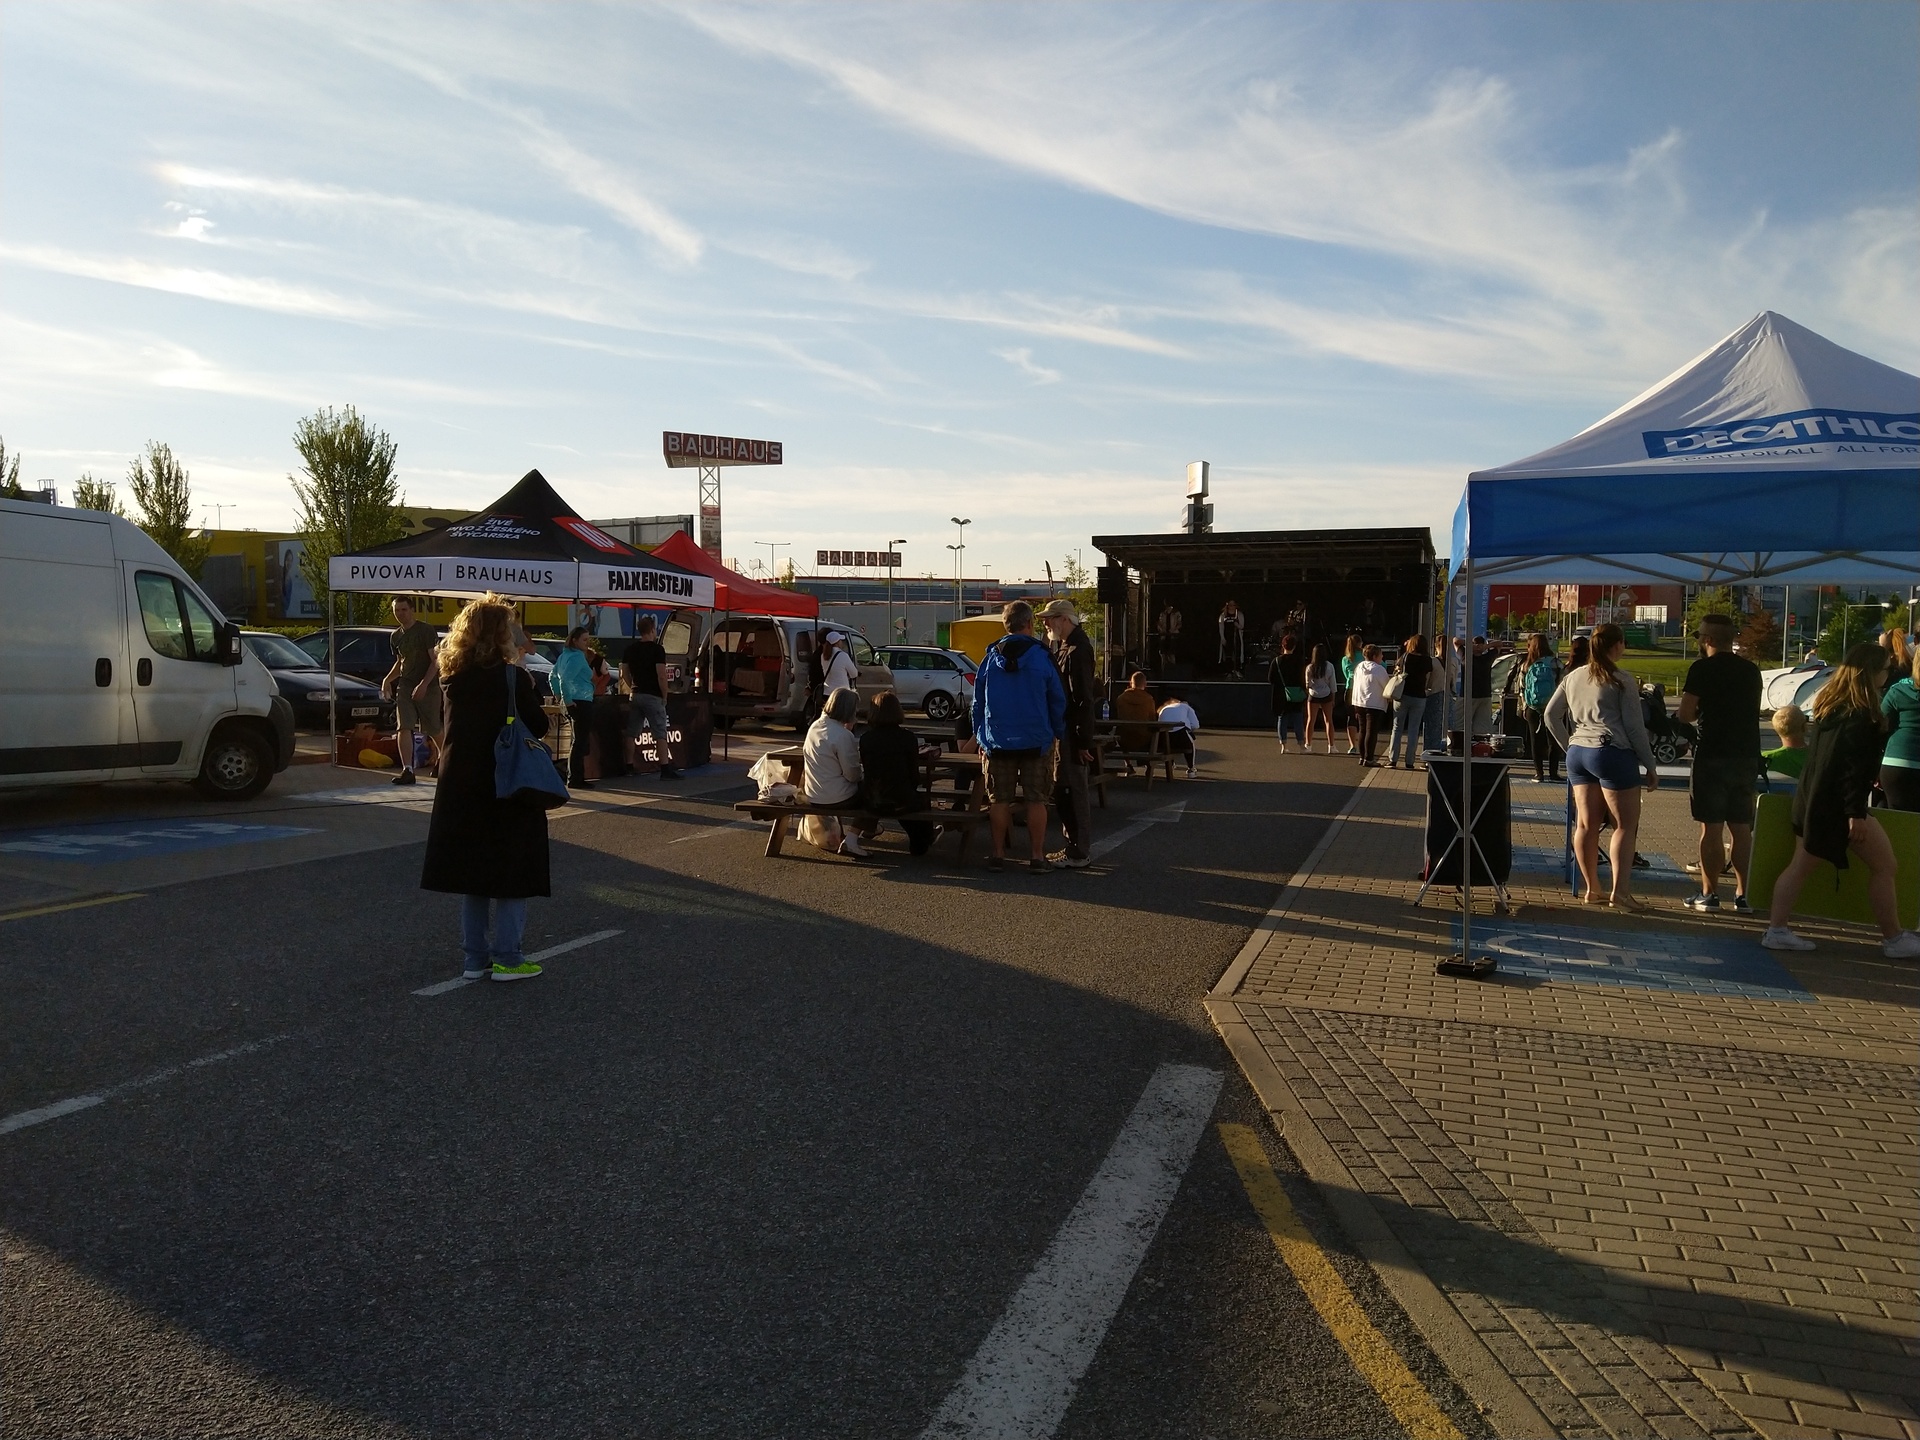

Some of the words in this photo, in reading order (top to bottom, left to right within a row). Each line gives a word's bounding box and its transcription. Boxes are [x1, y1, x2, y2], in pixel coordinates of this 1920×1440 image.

[668, 434, 781, 461] BAUHAUS
[1783, 446, 1823, 455] ALL
[1836, 445, 1875, 453] ALL
[485, 524, 541, 536] ČESKÉHO
[818, 551, 901, 566] BAUHAUS
[351, 564, 426, 579] PIVOVAR
[455, 564, 553, 585] BRAUHAUS
[607, 570, 693, 597] FALKENSTEJN
